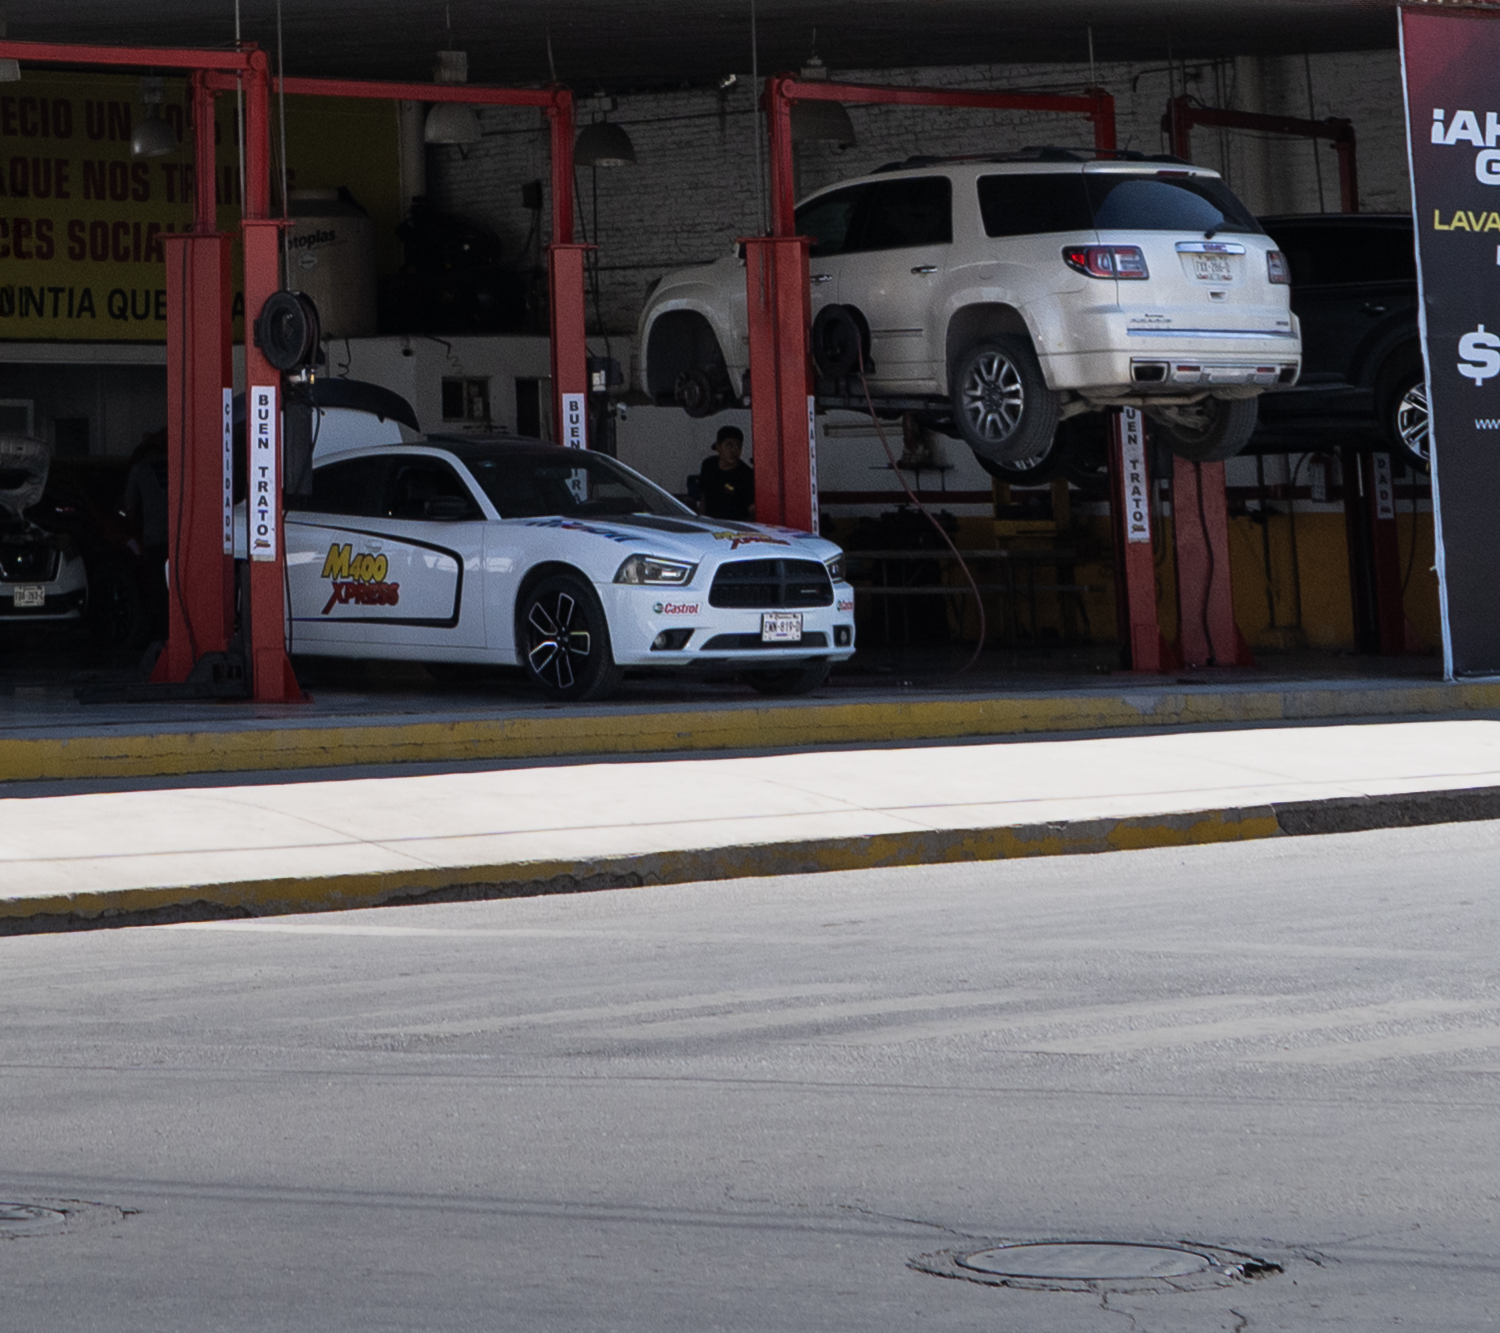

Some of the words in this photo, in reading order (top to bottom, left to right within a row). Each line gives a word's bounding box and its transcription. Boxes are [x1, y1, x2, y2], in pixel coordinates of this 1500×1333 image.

[81, 159, 151, 203] NOS
[257, 394, 270, 450] BUEN
[256, 465, 270, 537] TRATO
[664, 602, 699, 614] Castrol
